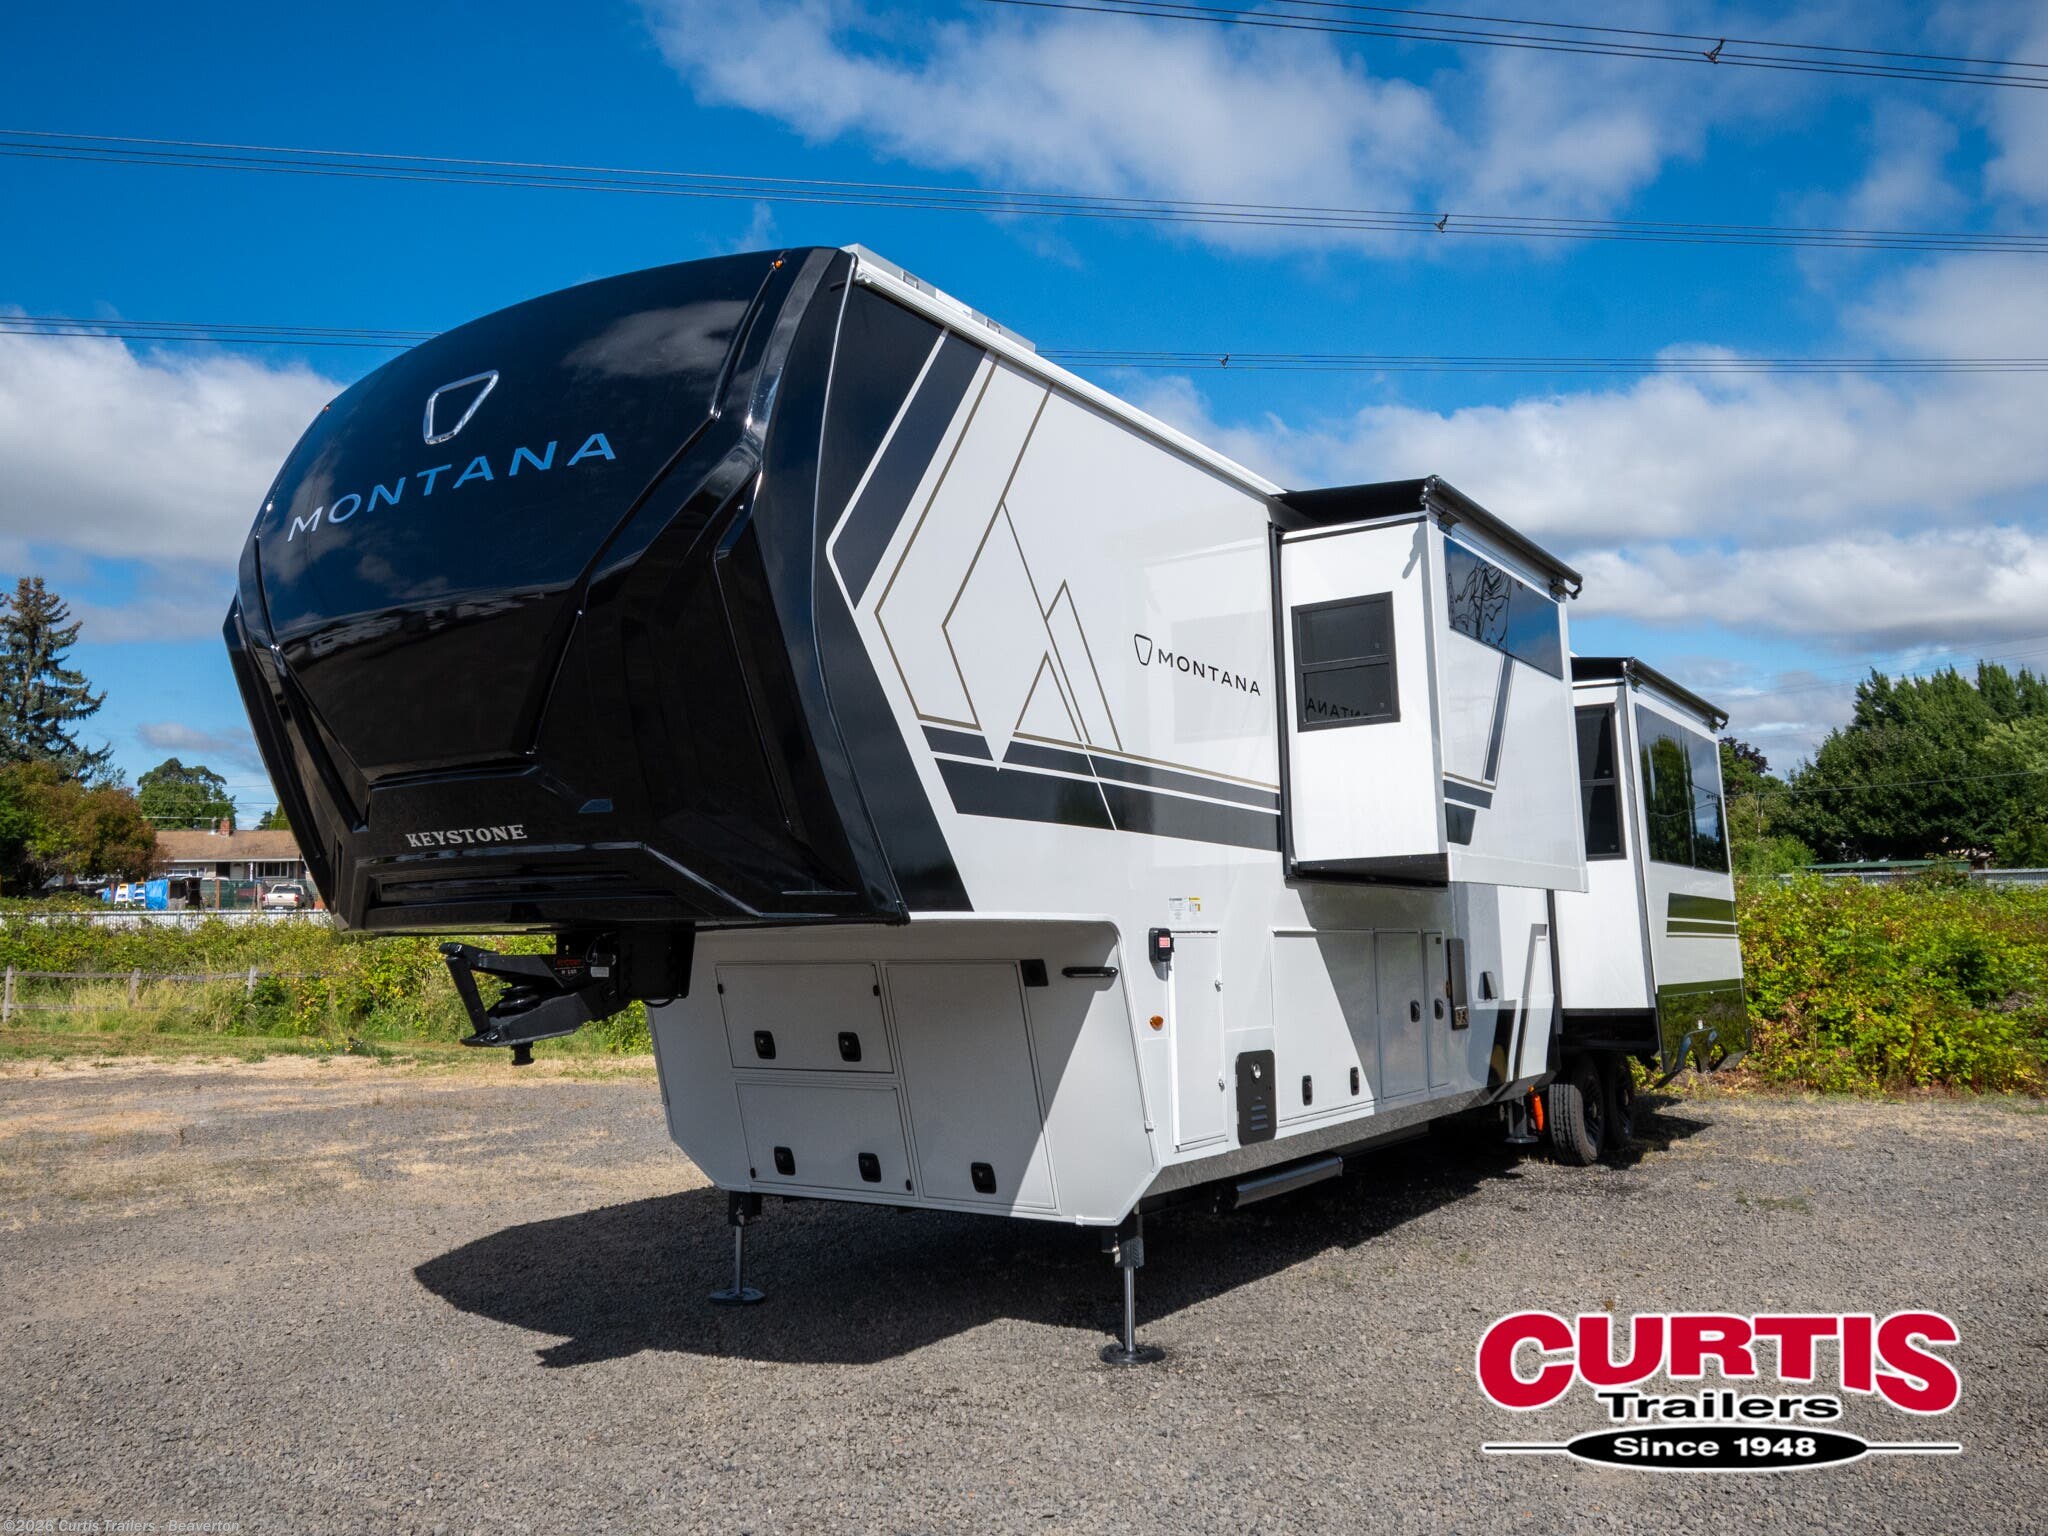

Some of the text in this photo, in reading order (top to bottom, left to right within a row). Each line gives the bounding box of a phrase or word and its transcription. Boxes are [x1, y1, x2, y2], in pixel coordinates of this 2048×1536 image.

[287, 432, 617, 542] MONTANA
[1158, 648, 1261, 696] MONTANA
[406, 823, 528, 848] KEYSTONE
